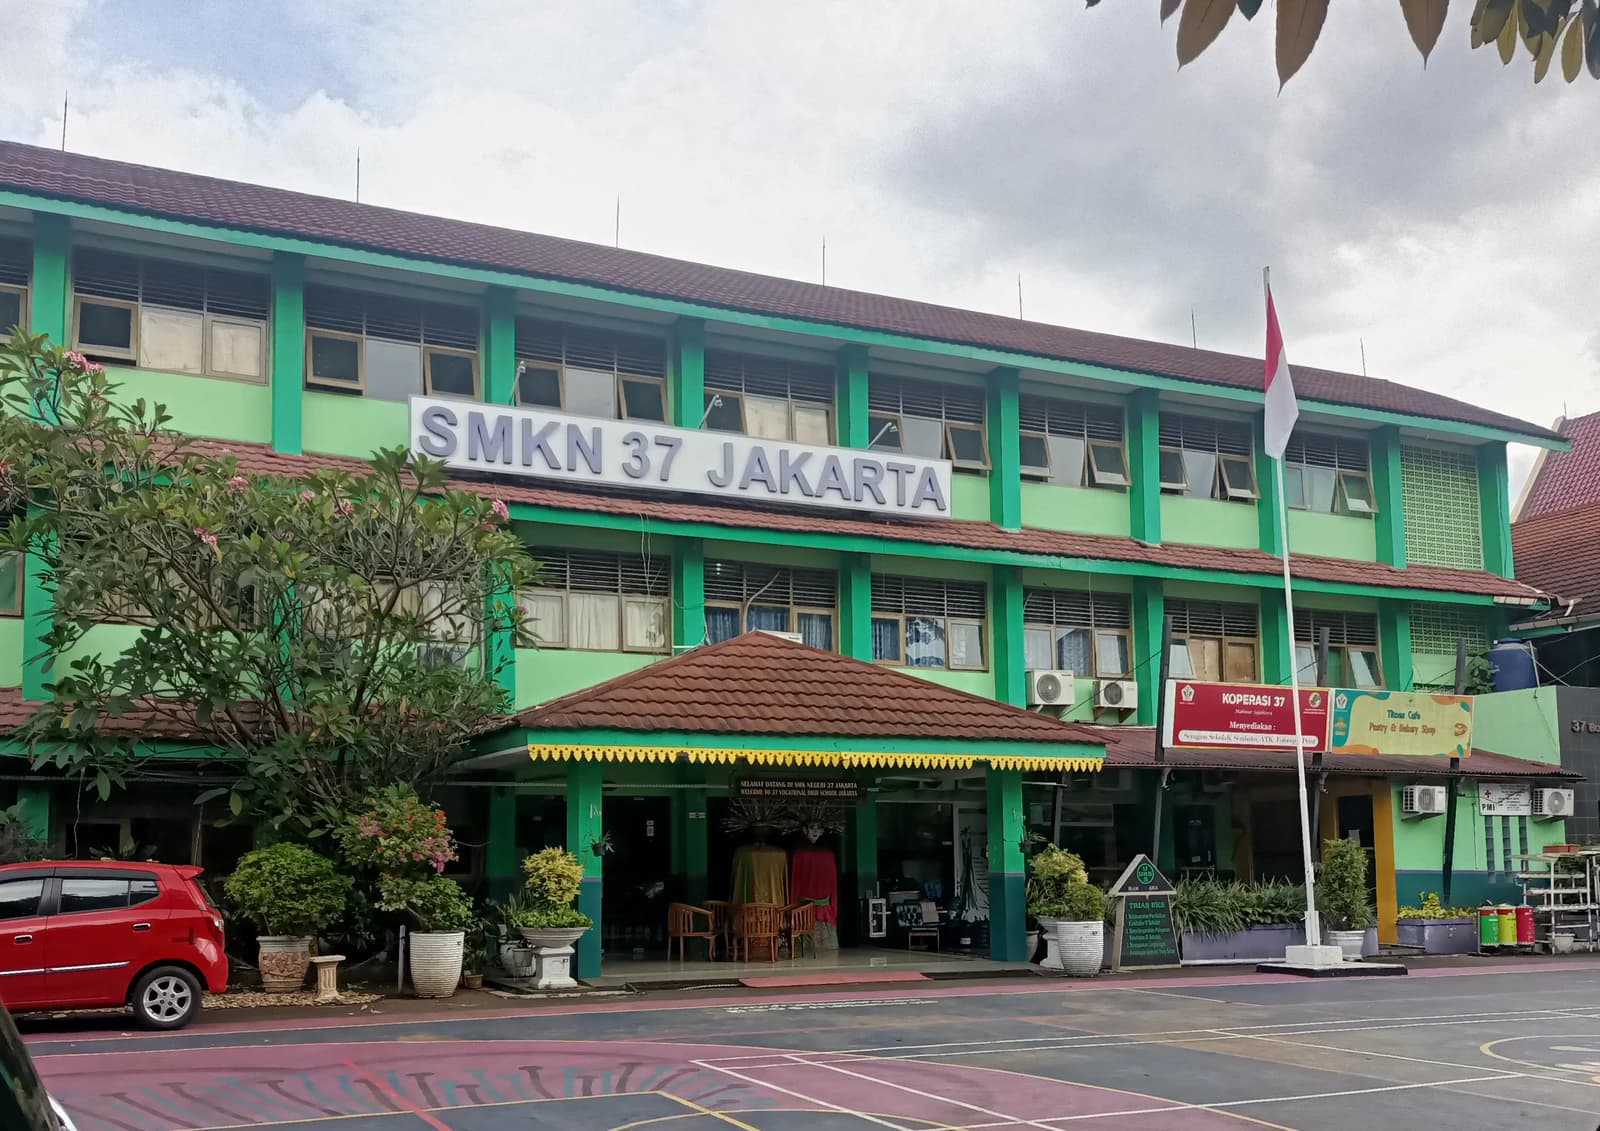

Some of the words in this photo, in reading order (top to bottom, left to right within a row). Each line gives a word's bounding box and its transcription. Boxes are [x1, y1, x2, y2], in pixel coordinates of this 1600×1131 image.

[419, 406, 601, 474] SMKN
[621, 431, 683, 481] 37
[706, 442, 946, 511] JAKARTA
[1222, 692, 1271, 707] KOPERASI
[1274, 696, 1285, 708] 37
[1571, 719, 1586, 732] 37
[1481, 803, 1496, 811] PMI
